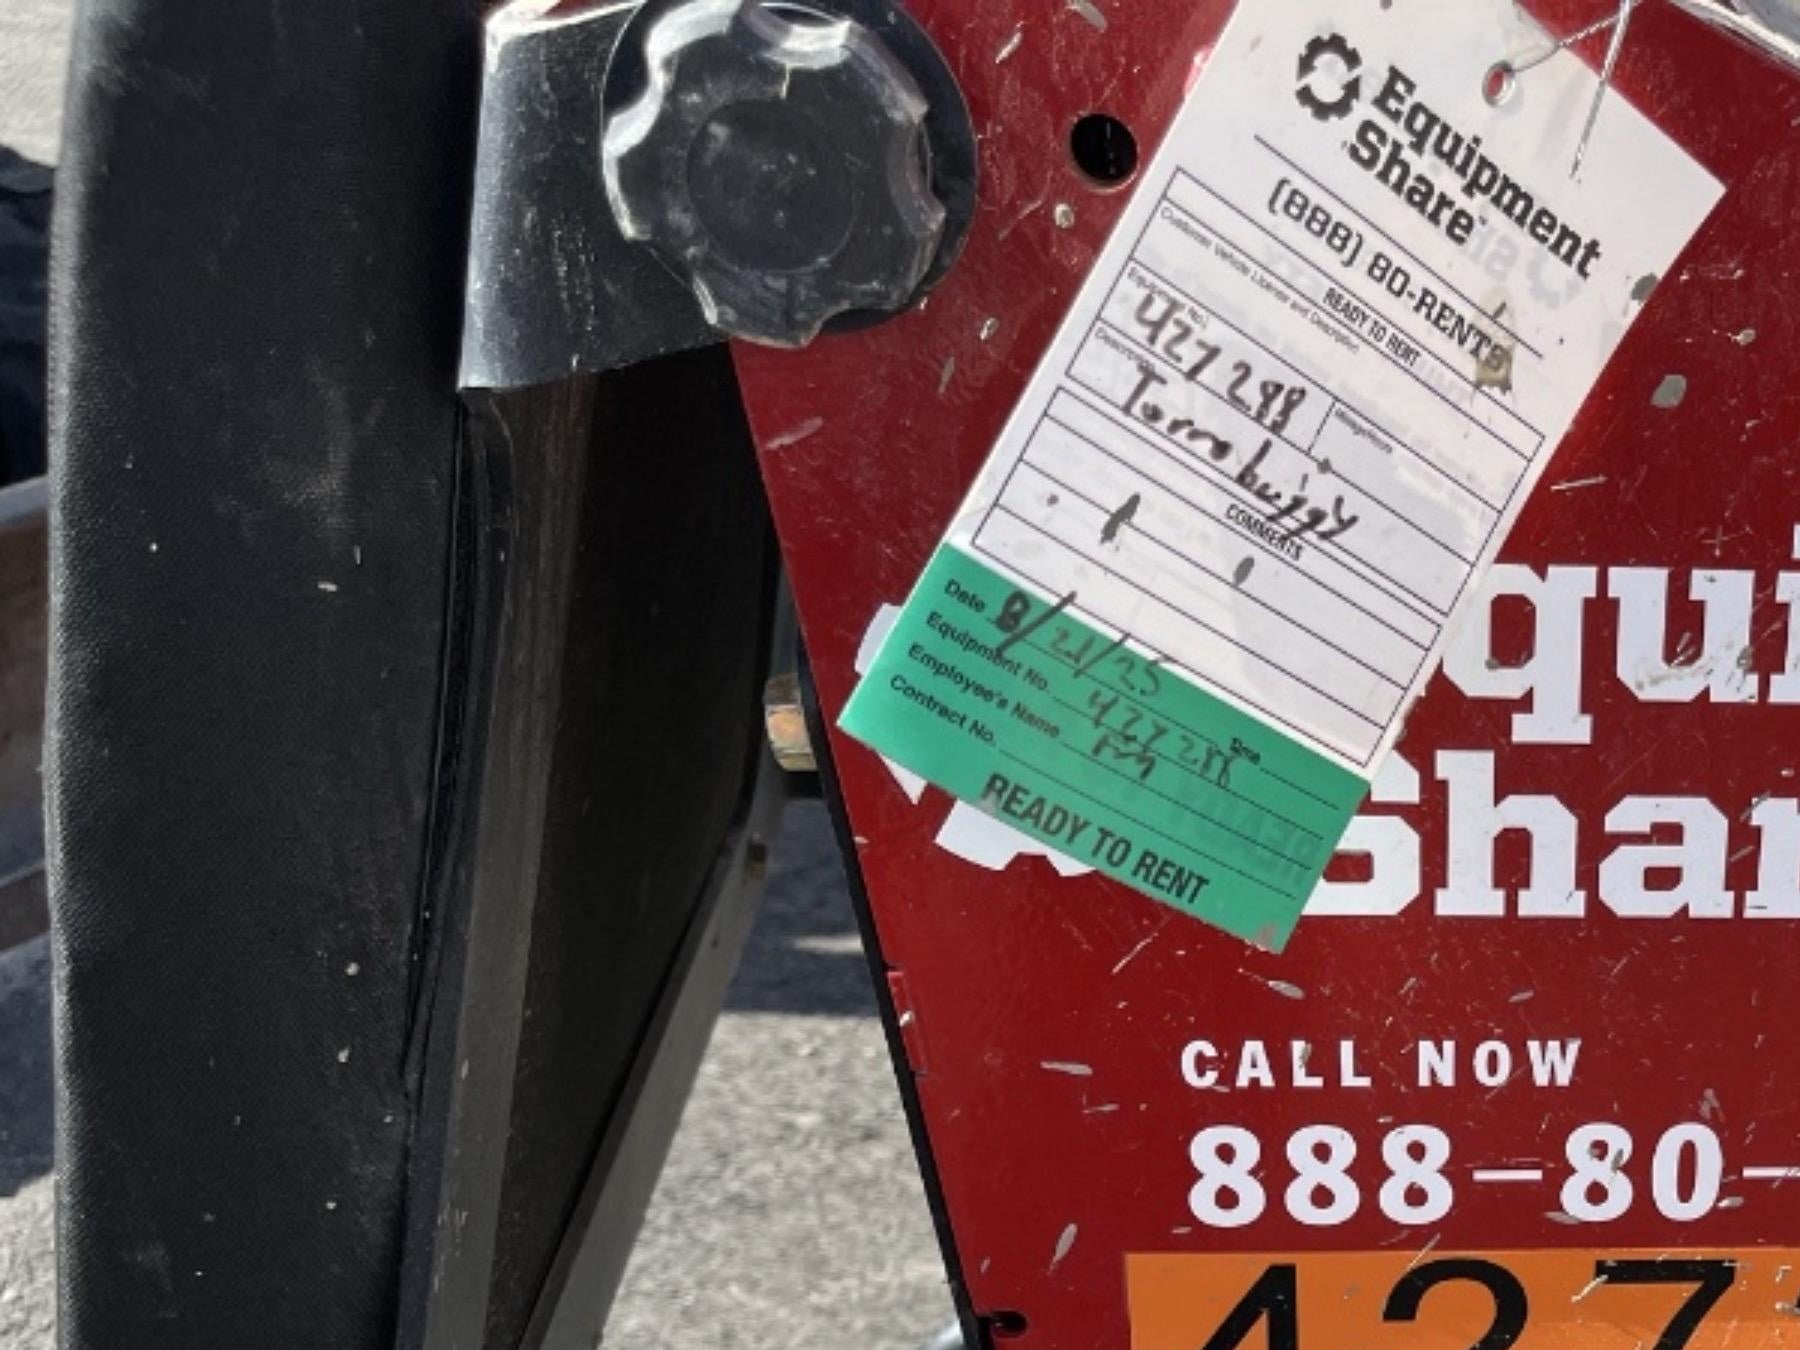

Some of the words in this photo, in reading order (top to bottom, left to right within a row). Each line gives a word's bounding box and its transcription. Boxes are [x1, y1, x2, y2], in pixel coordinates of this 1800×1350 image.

[1349, 119, 1475, 245] Share
[1371, 65, 1602, 280] Equipment
[1267, 177, 1363, 267] (888)
[1251, 269, 1290, 305] License
[1290, 299, 1310, 318] and
[1323, 287, 1369, 329] READY
[1368, 319, 1387, 342] TO
[1386, 332, 1422, 368] RENT
[1225, 503, 1303, 560] COMMENTS
[945, 579, 986, 612] Date
[909, 642, 1008, 708] Employee's
[1010, 702, 1060, 739] Name
[926, 611, 1023, 680] Equipment
[1027, 667, 1050, 693] No.
[890, 674, 969, 727] Contract
[968, 720, 997, 744] No.
[981, 773, 1092, 845] READY
[1092, 827, 1133, 868] TO
[1131, 849, 1211, 905] RENT
[1181, 1039, 1372, 1089] CALL
[1416, 1038, 1583, 1086] NOW
